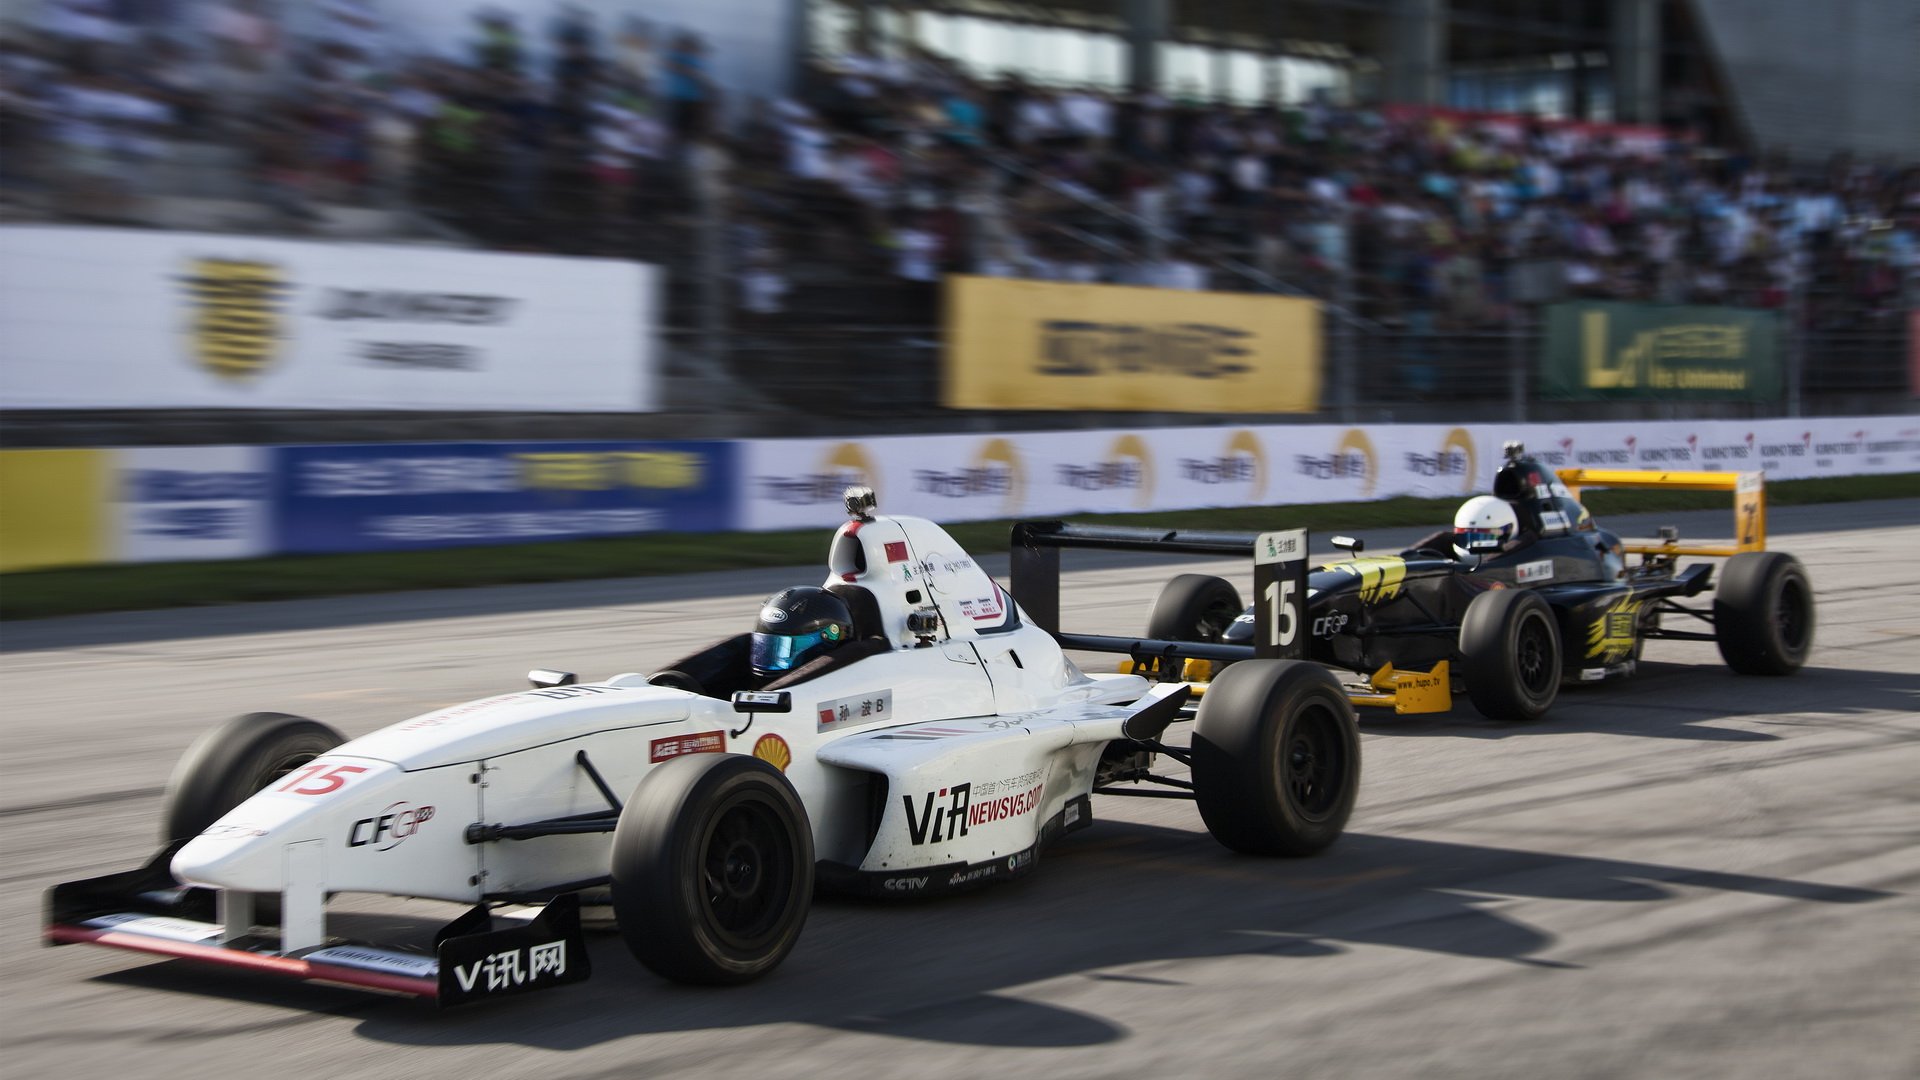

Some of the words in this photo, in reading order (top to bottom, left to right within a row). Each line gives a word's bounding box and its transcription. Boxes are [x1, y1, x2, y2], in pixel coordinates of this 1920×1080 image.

[1265, 579, 1298, 647] 15
[276, 763, 359, 796] 15
[883, 876, 929, 890] CCTV
[453, 939, 567, 993] V讯网
